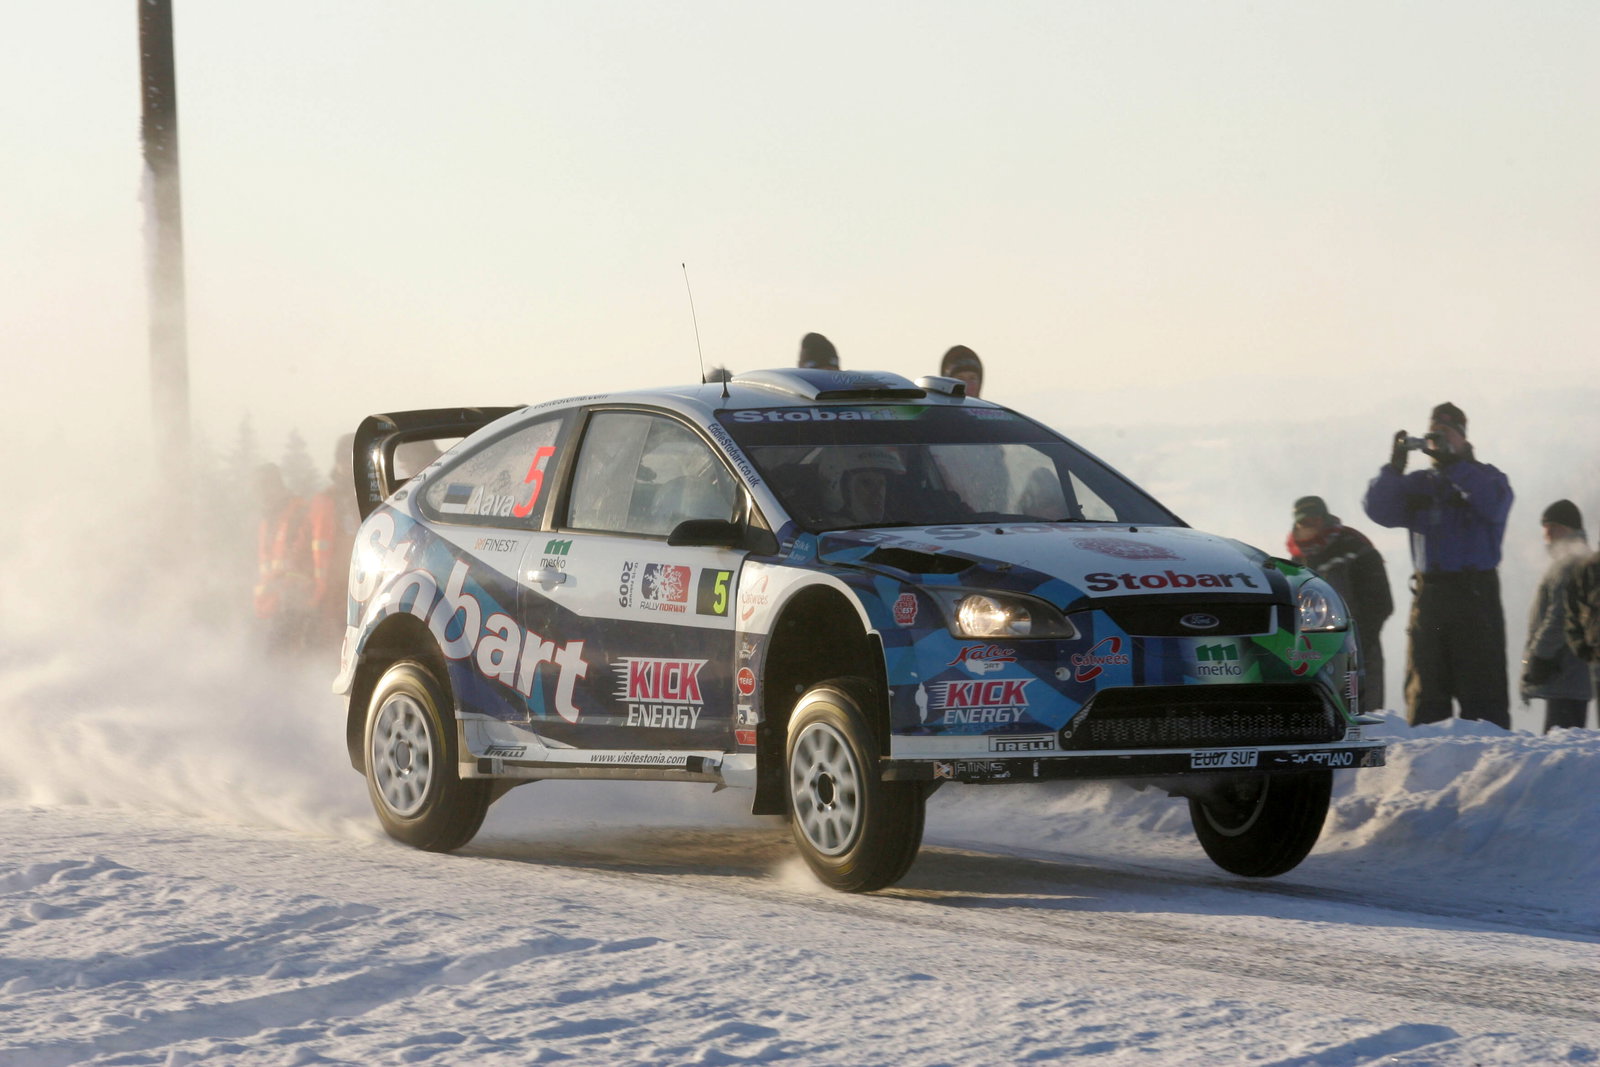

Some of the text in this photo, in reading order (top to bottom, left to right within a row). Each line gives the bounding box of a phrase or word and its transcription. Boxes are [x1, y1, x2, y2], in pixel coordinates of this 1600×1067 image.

[732, 407, 897, 424] Stobart
[708, 422, 760, 488] EddieStobart.co.uk
[513, 446, 556, 518] 5
[540, 556, 567, 569] merko
[618, 561, 634, 608] 2009
[713, 571, 730, 615] 5
[1083, 570, 1259, 593] Stobart
[1198, 663, 1242, 676] merko
[628, 661, 702, 704] KICK
[946, 681, 1028, 707] KICK
[627, 705, 702, 730] ENERGY
[943, 708, 1026, 724] ENERGY
[989, 736, 1055, 752] PIRELLI
[590, 751, 686, 765] www.visitestonia.com
[1194, 751, 1257, 766] EU07 SUF
